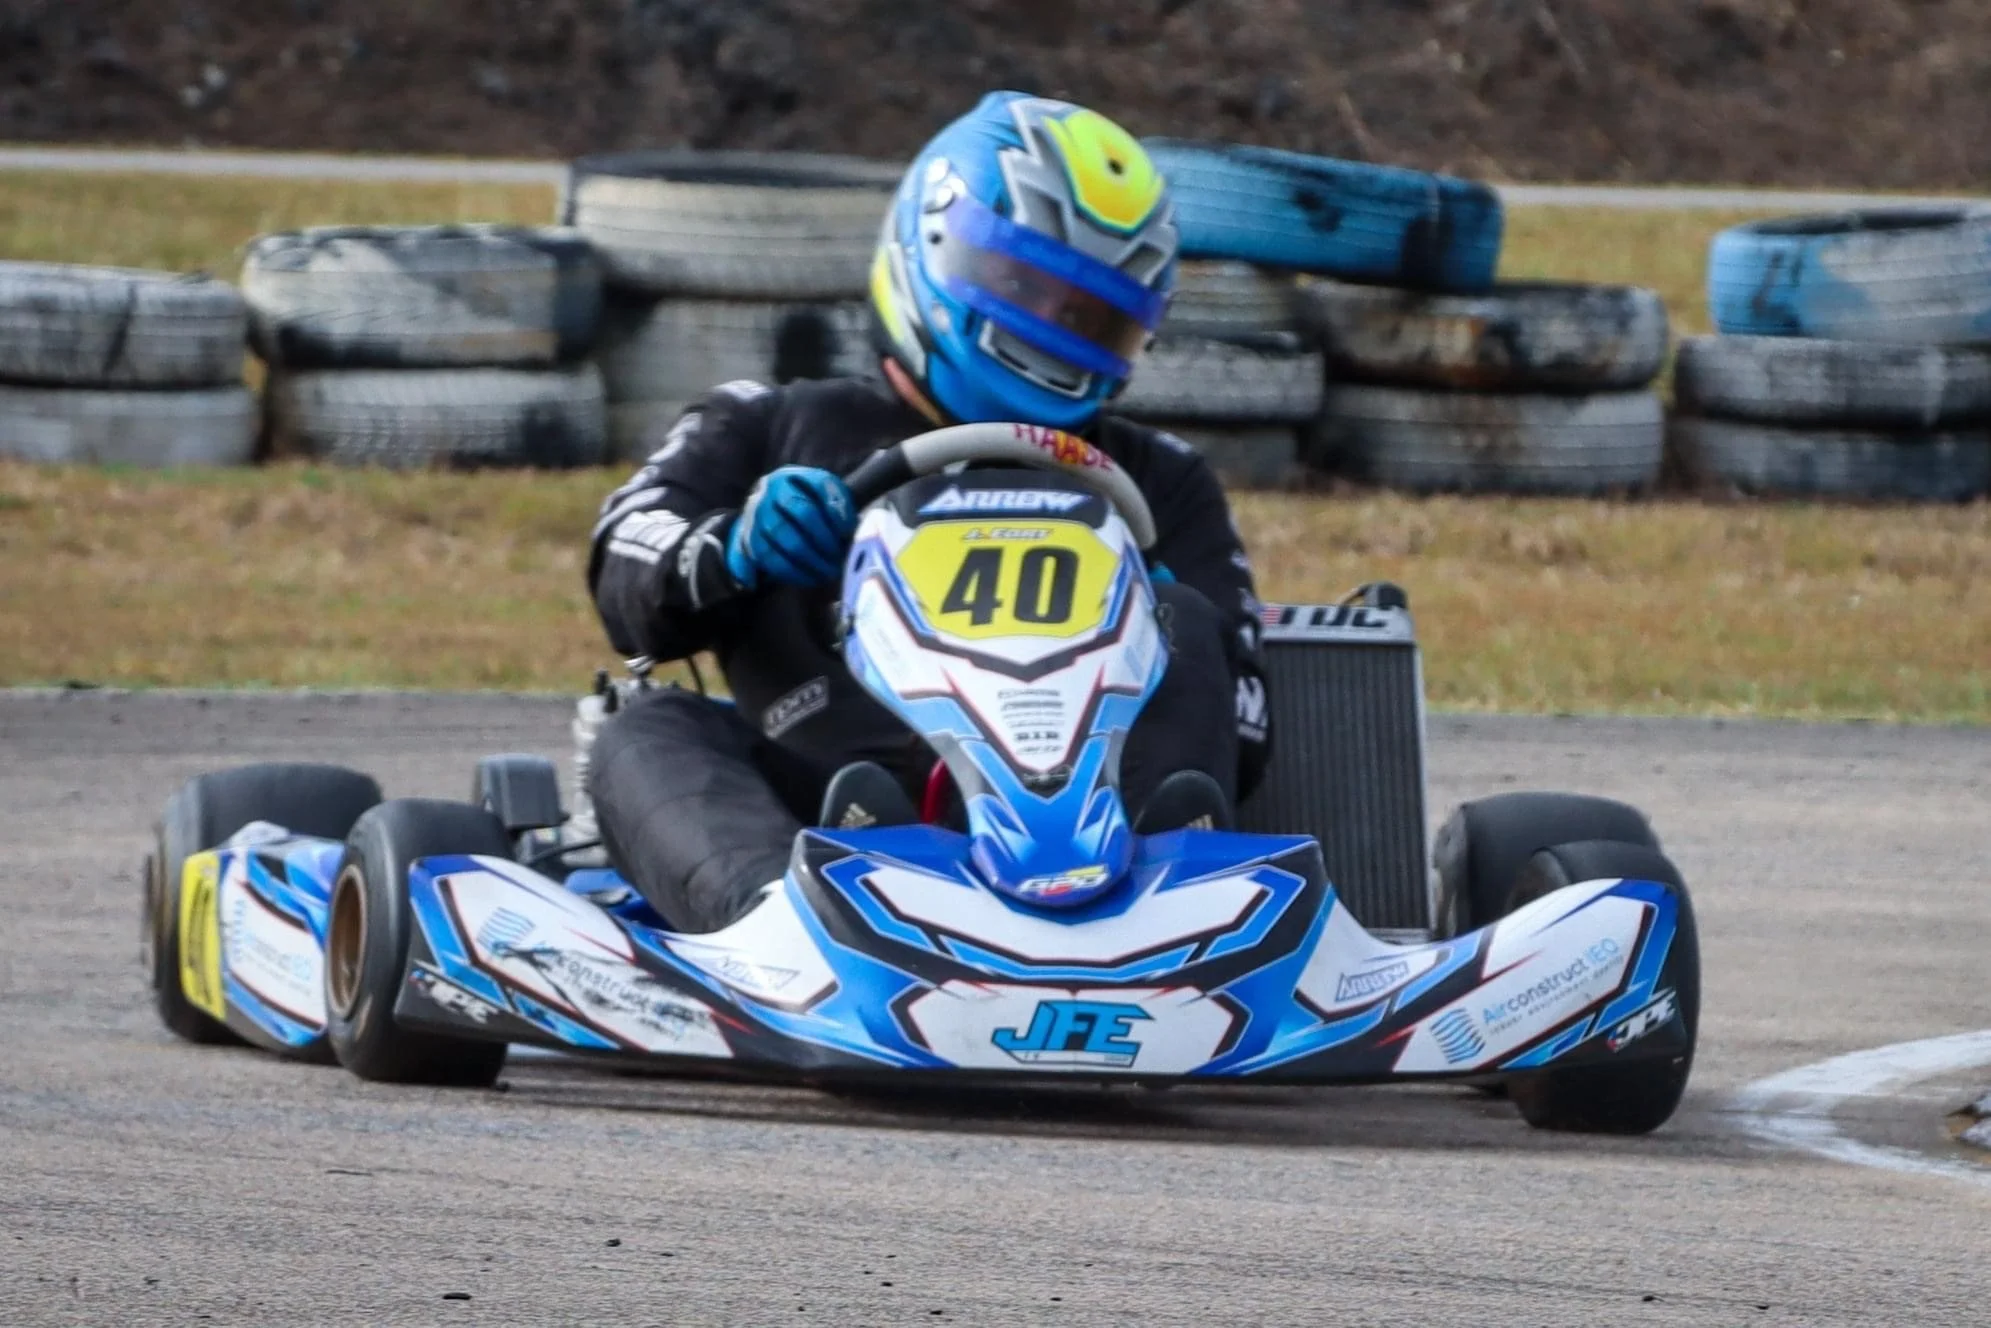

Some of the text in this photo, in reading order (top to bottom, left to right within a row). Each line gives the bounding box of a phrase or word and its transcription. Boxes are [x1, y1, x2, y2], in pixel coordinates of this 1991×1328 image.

[941, 546, 1079, 626] 40
[1482, 957, 1590, 1024] Airconstruct
[991, 1000, 1155, 1055] JFE
